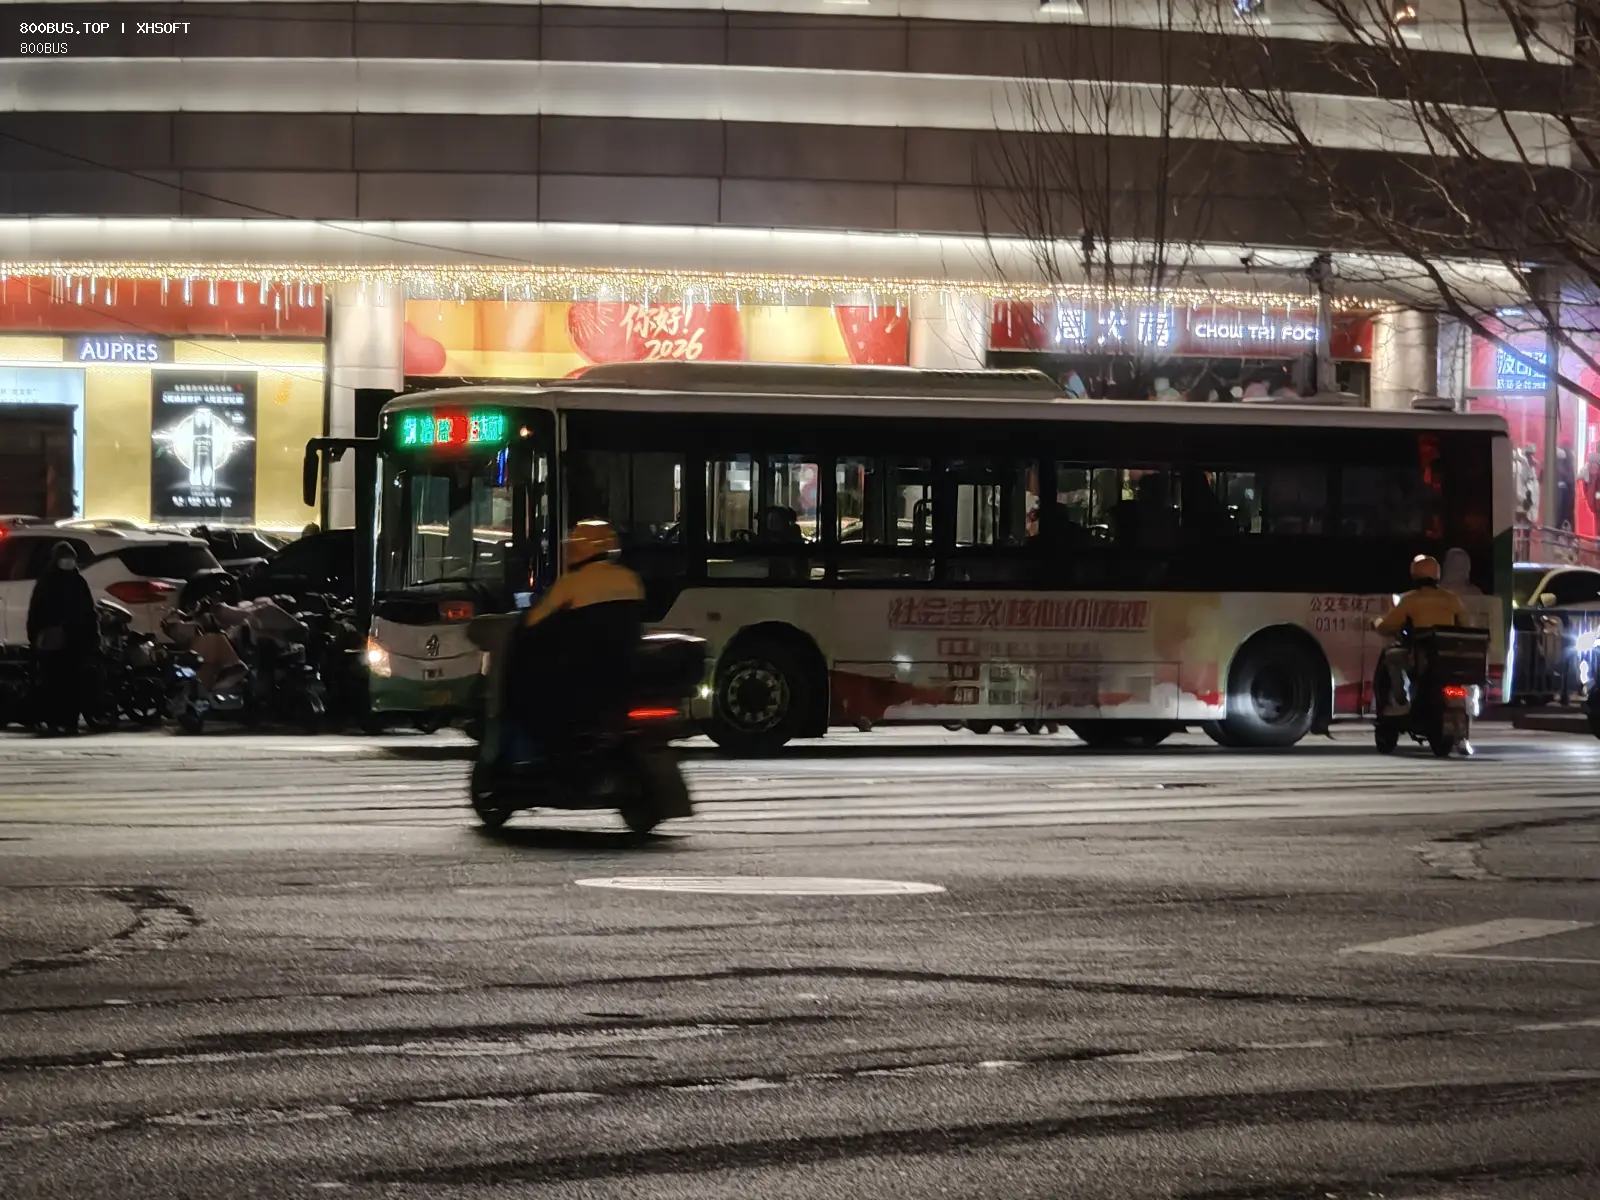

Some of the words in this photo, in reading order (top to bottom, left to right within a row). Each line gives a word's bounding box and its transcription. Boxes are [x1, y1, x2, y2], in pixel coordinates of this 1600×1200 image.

[1195, 324, 1243, 339] CHOW
[1247, 325, 1275, 340] TAI
[80, 342, 159, 361] AUPRES
[641, 328, 705, 362] 2026
